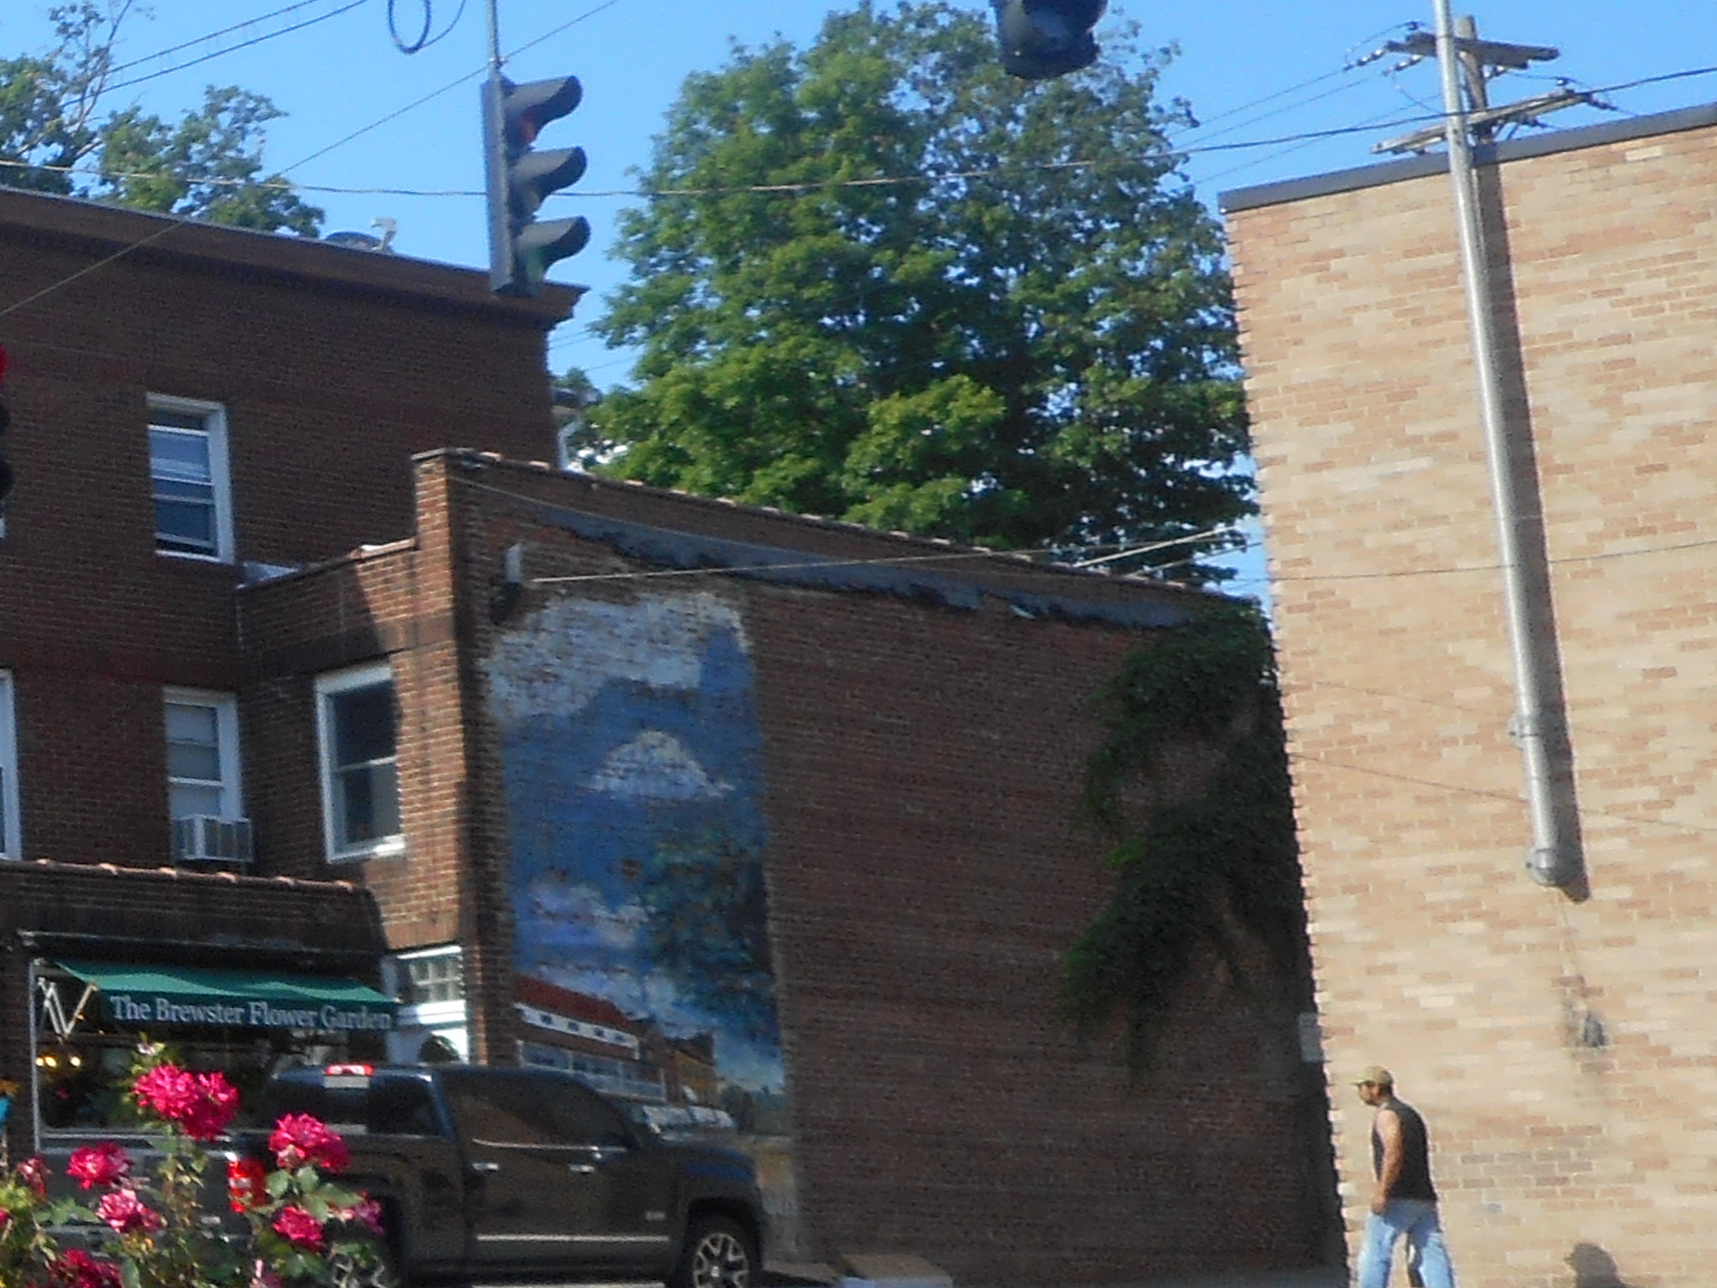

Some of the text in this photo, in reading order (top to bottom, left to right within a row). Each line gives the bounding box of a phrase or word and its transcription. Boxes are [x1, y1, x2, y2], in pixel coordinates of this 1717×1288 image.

[110, 995, 392, 1029] The Brewster Flower Garden
